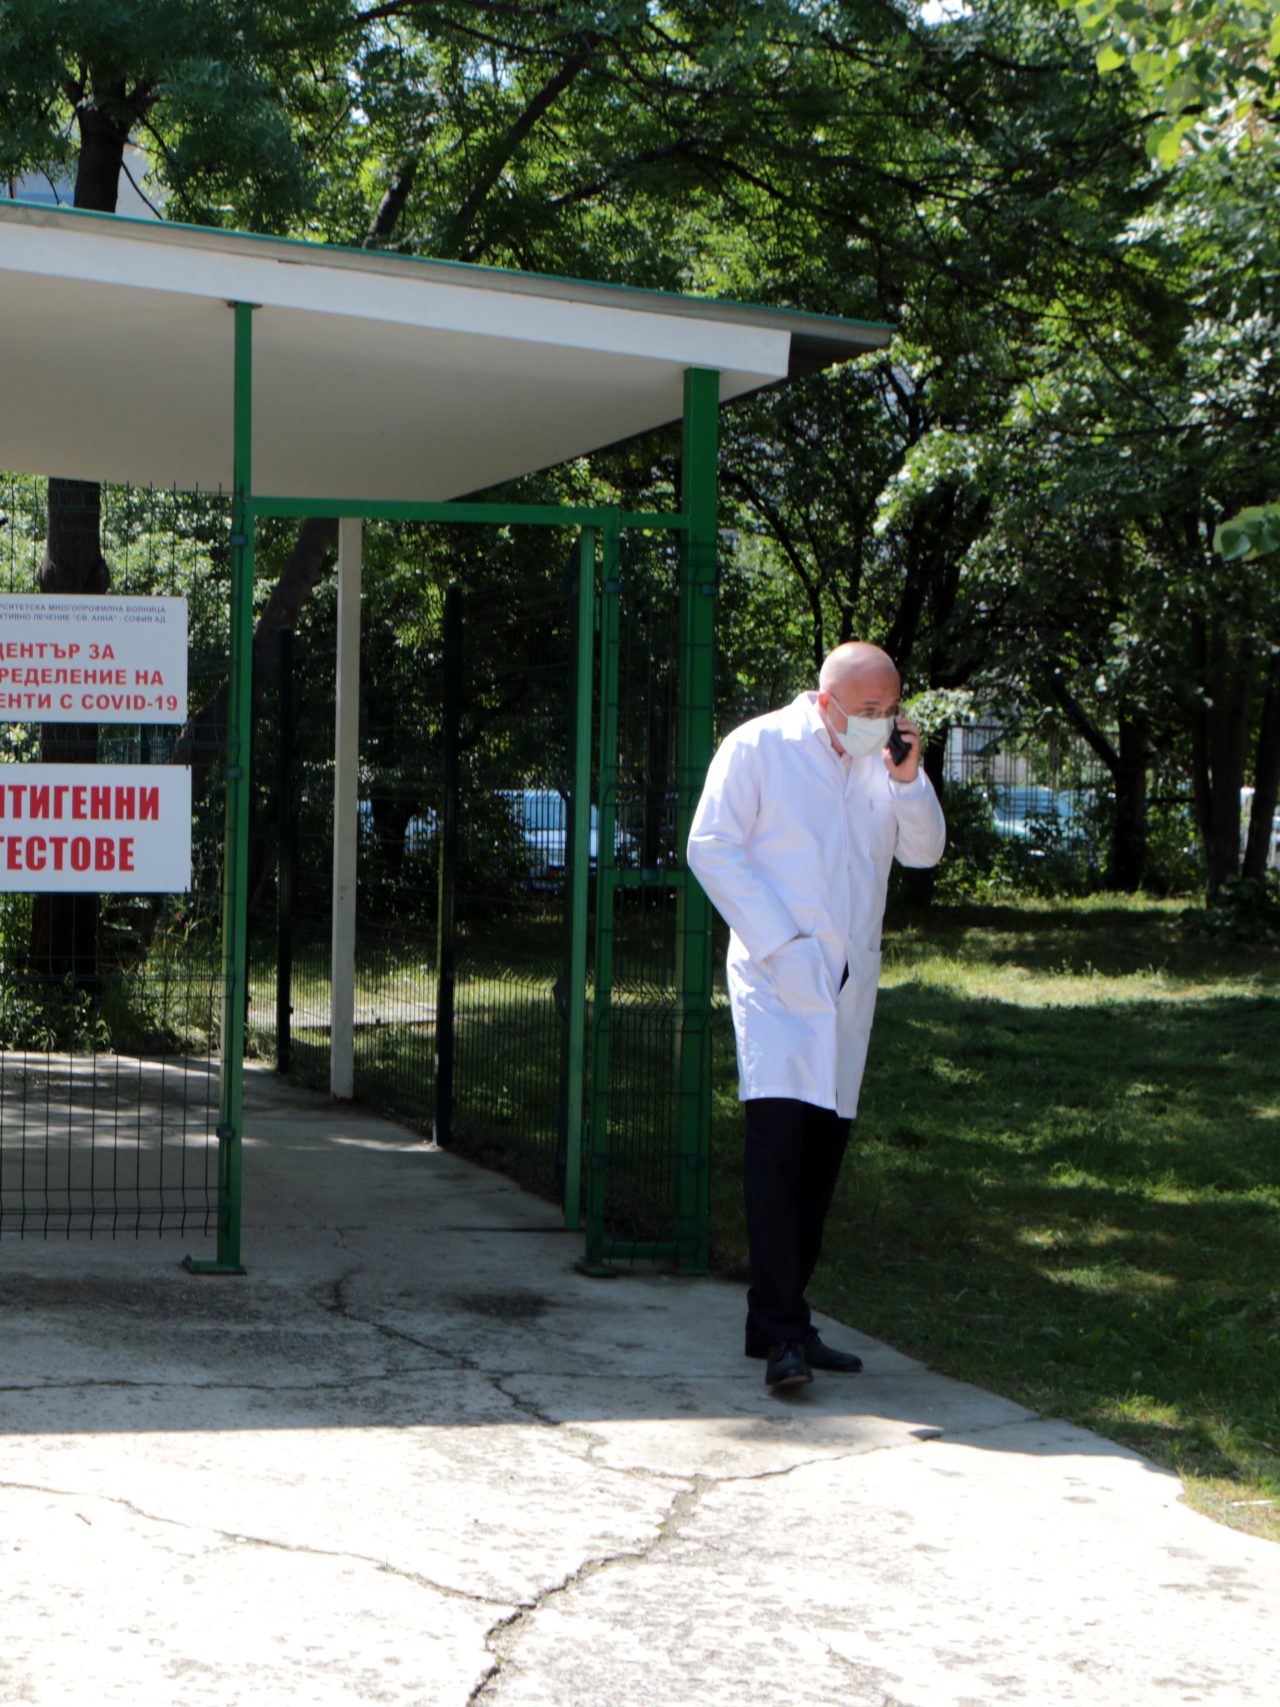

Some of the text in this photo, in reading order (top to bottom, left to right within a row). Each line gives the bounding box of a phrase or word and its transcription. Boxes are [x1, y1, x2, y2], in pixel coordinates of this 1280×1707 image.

[88, 644, 115, 660] ЗА
[135, 670, 164, 686] НА
[60, 694, 73, 710] С
[81, 694, 178, 711] COVID-19
